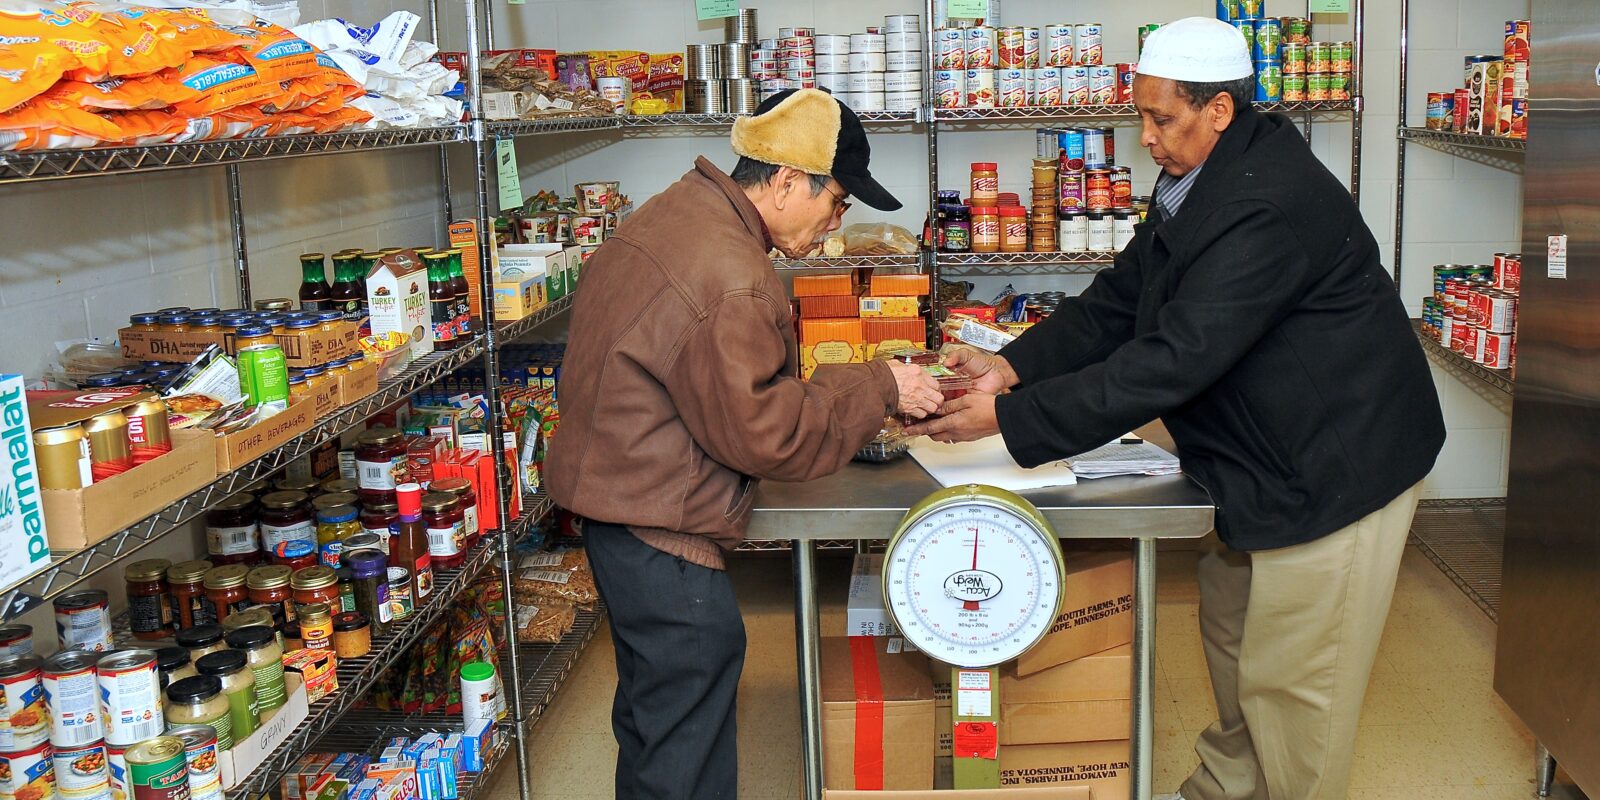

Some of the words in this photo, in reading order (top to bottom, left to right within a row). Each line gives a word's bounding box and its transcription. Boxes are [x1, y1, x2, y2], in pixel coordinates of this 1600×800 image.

[262, 42, 303, 58] RESEALABLE
[193, 66, 246, 90] RESEALABLE
[371, 297, 396, 305] TURKEY
[404, 291, 426, 312] TURKEY
[150, 342, 179, 355] DHA
[316, 390, 329, 405] DHA
[238, 434, 263, 454] OTHER
[267, 412, 306, 442] BEVERAGES
[0, 385, 50, 564] parmalat
[953, 575, 984, 587] Weigh
[960, 587, 990, 597] Accu-
[1056, 608, 1086, 624] MOUTH
[1087, 600, 1116, 614] FARMS,
[1074, 608, 1120, 627] MINNESOTA
[306, 640, 330, 649] Mustard
[260, 714, 287, 750] GRAVY
[1017, 766, 1075, 776] MINNESOTA
[1077, 764, 1106, 772] HOPE,
[1110, 761, 1130, 769] NEW
[1060, 770, 1117, 782] WAYMOUTH
